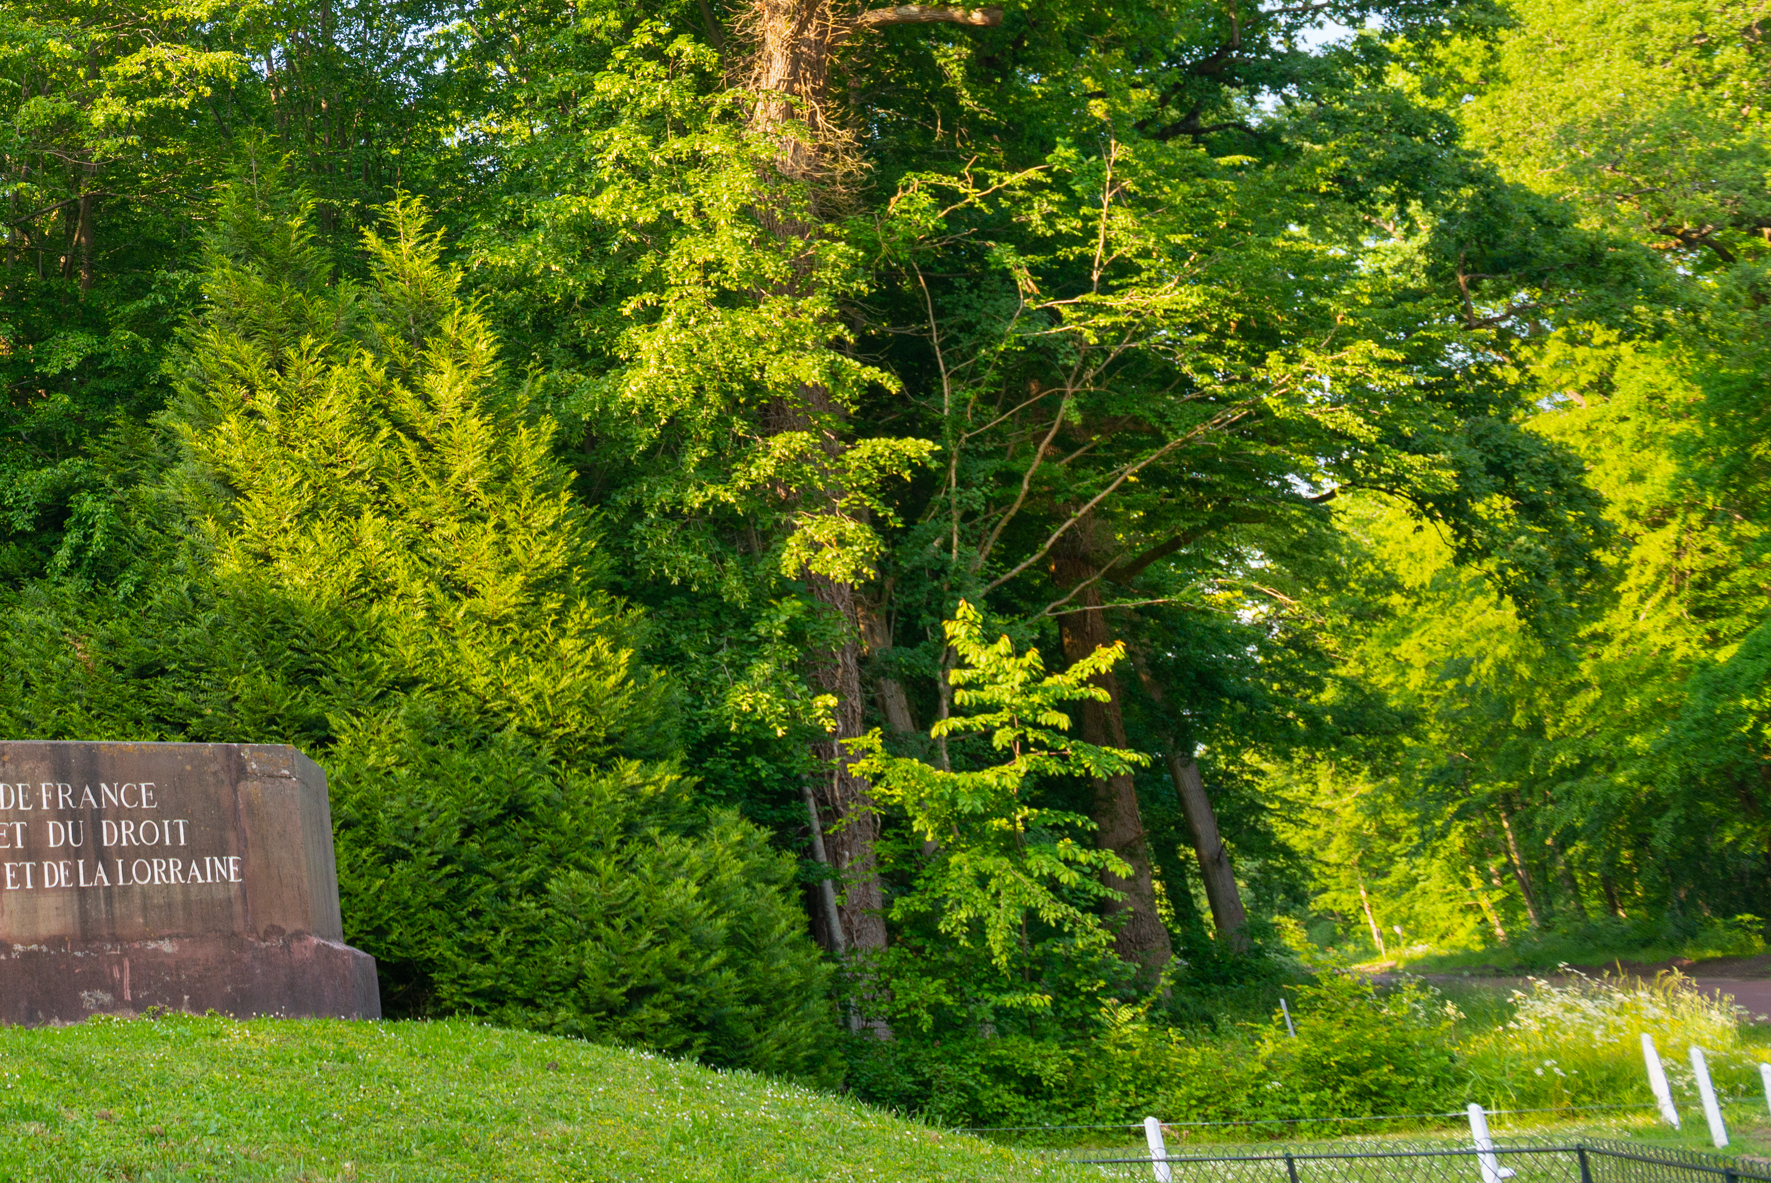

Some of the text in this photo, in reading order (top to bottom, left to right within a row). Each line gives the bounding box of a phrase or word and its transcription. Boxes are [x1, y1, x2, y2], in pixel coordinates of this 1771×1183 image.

[41, 781, 158, 809] FRANCE
[47, 820, 84, 848] DU
[102, 819, 190, 847] DROIT
[5, 861, 36, 890] ET
[42, 860, 74, 889] DE
[77, 859, 111, 888] LA
[116, 856, 243, 886] LORRAINE
